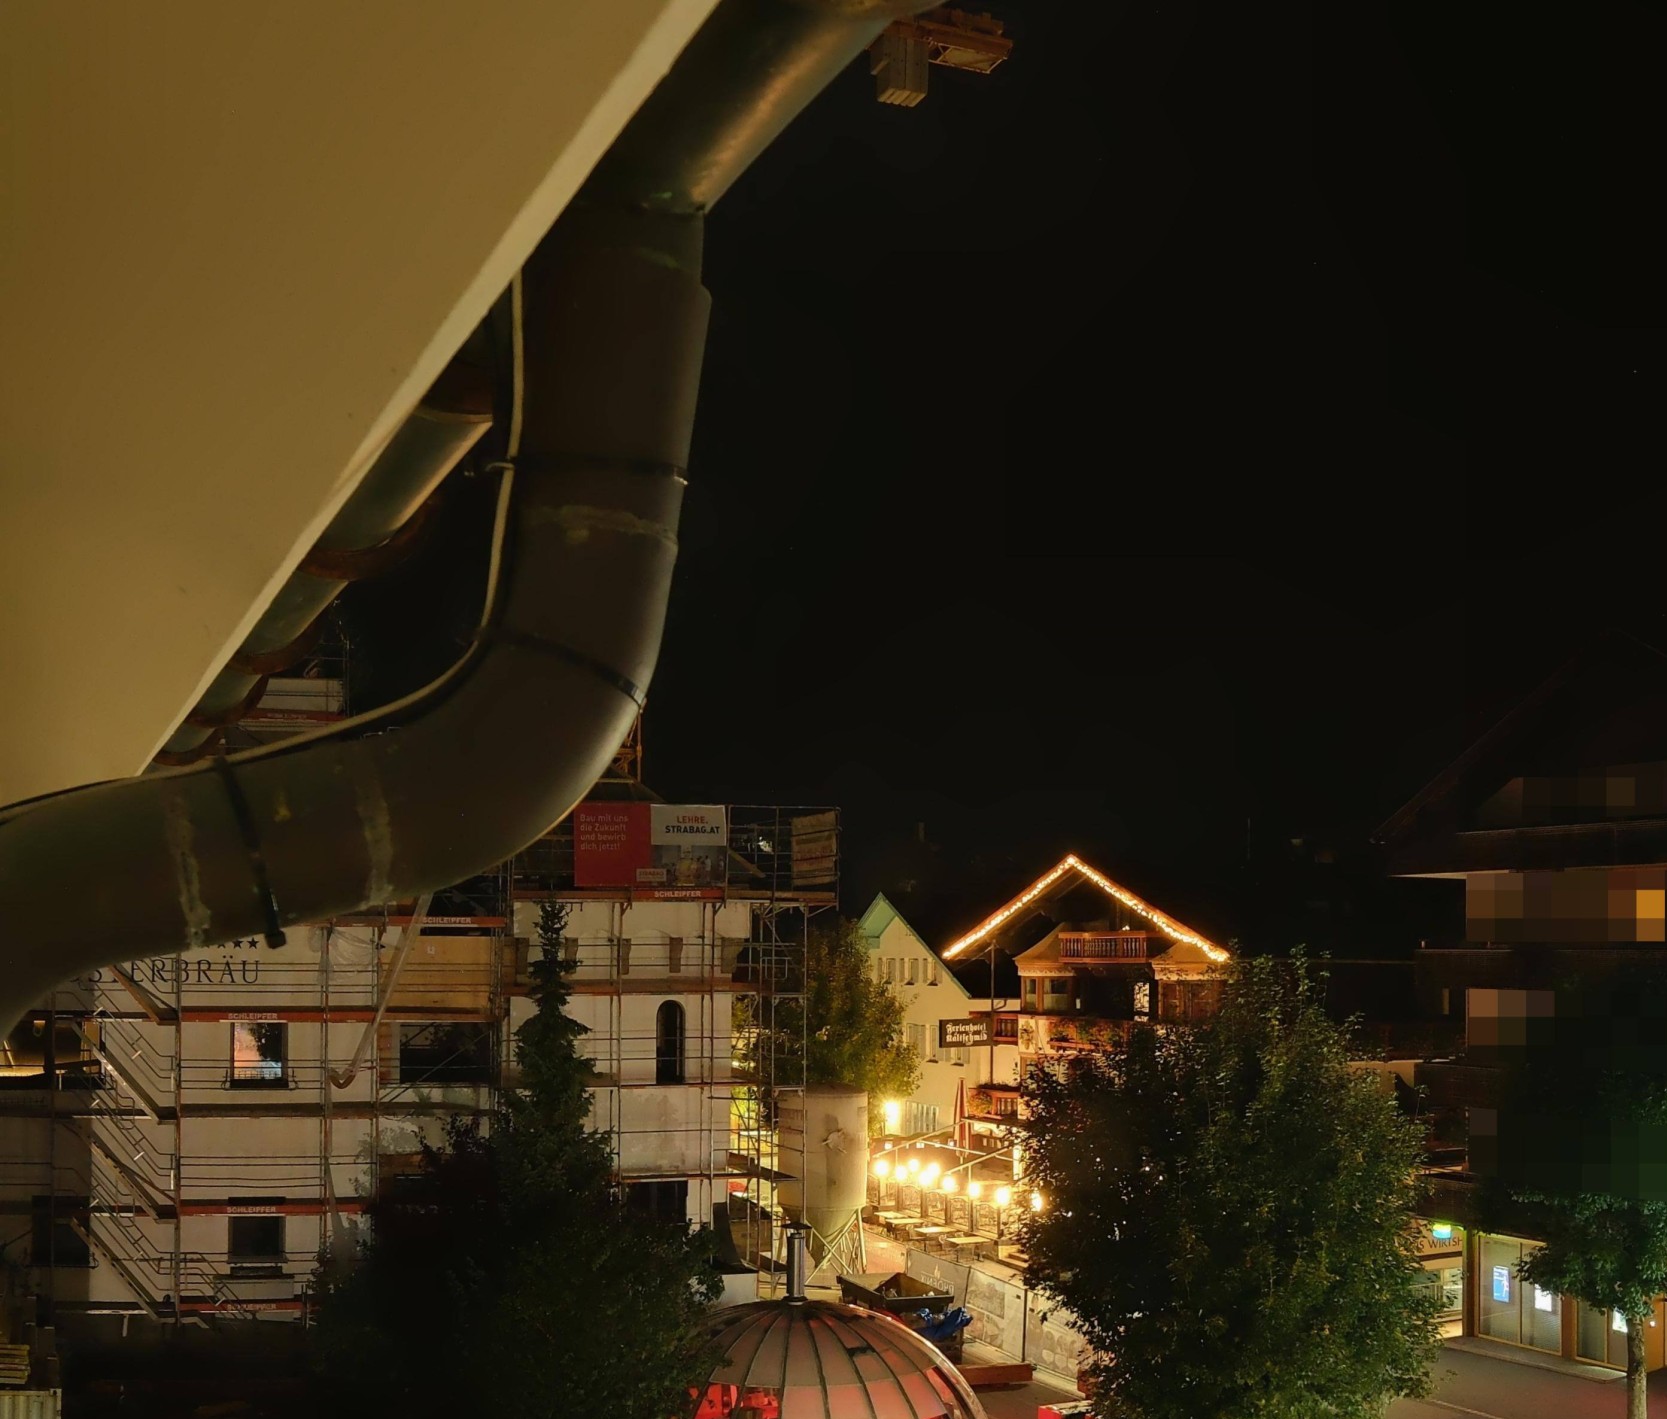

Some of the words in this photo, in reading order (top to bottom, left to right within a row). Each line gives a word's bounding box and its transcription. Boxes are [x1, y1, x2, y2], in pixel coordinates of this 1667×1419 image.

[676, 815, 709, 824] LEHRE.
[665, 825, 720, 834] STRABAG.AT
[654, 890, 702, 898] SCHLEIPFER
[423, 916, 472, 924] SCHLEIPFER
[228, 1013, 278, 1021] SCHLEIPFER
